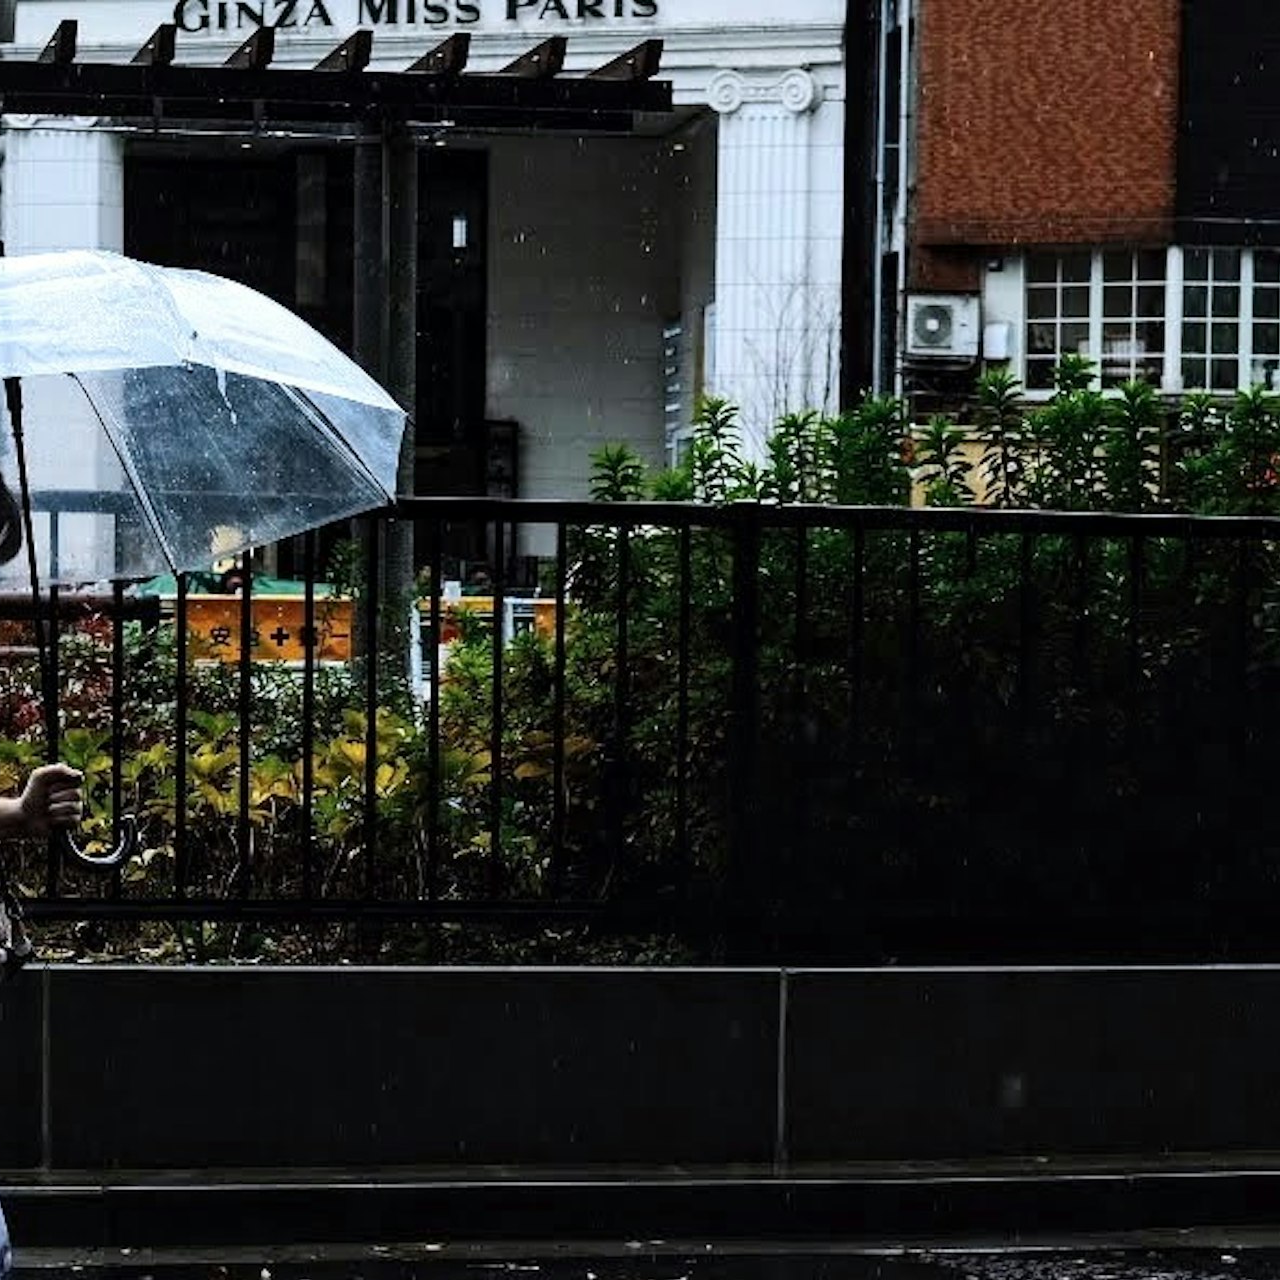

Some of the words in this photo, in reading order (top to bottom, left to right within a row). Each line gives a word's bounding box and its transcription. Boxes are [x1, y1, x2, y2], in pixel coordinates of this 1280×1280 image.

[174, 0, 333, 32] GINZA
[357, 0, 481, 25] MISS
[506, 0, 659, 20] PARIS
